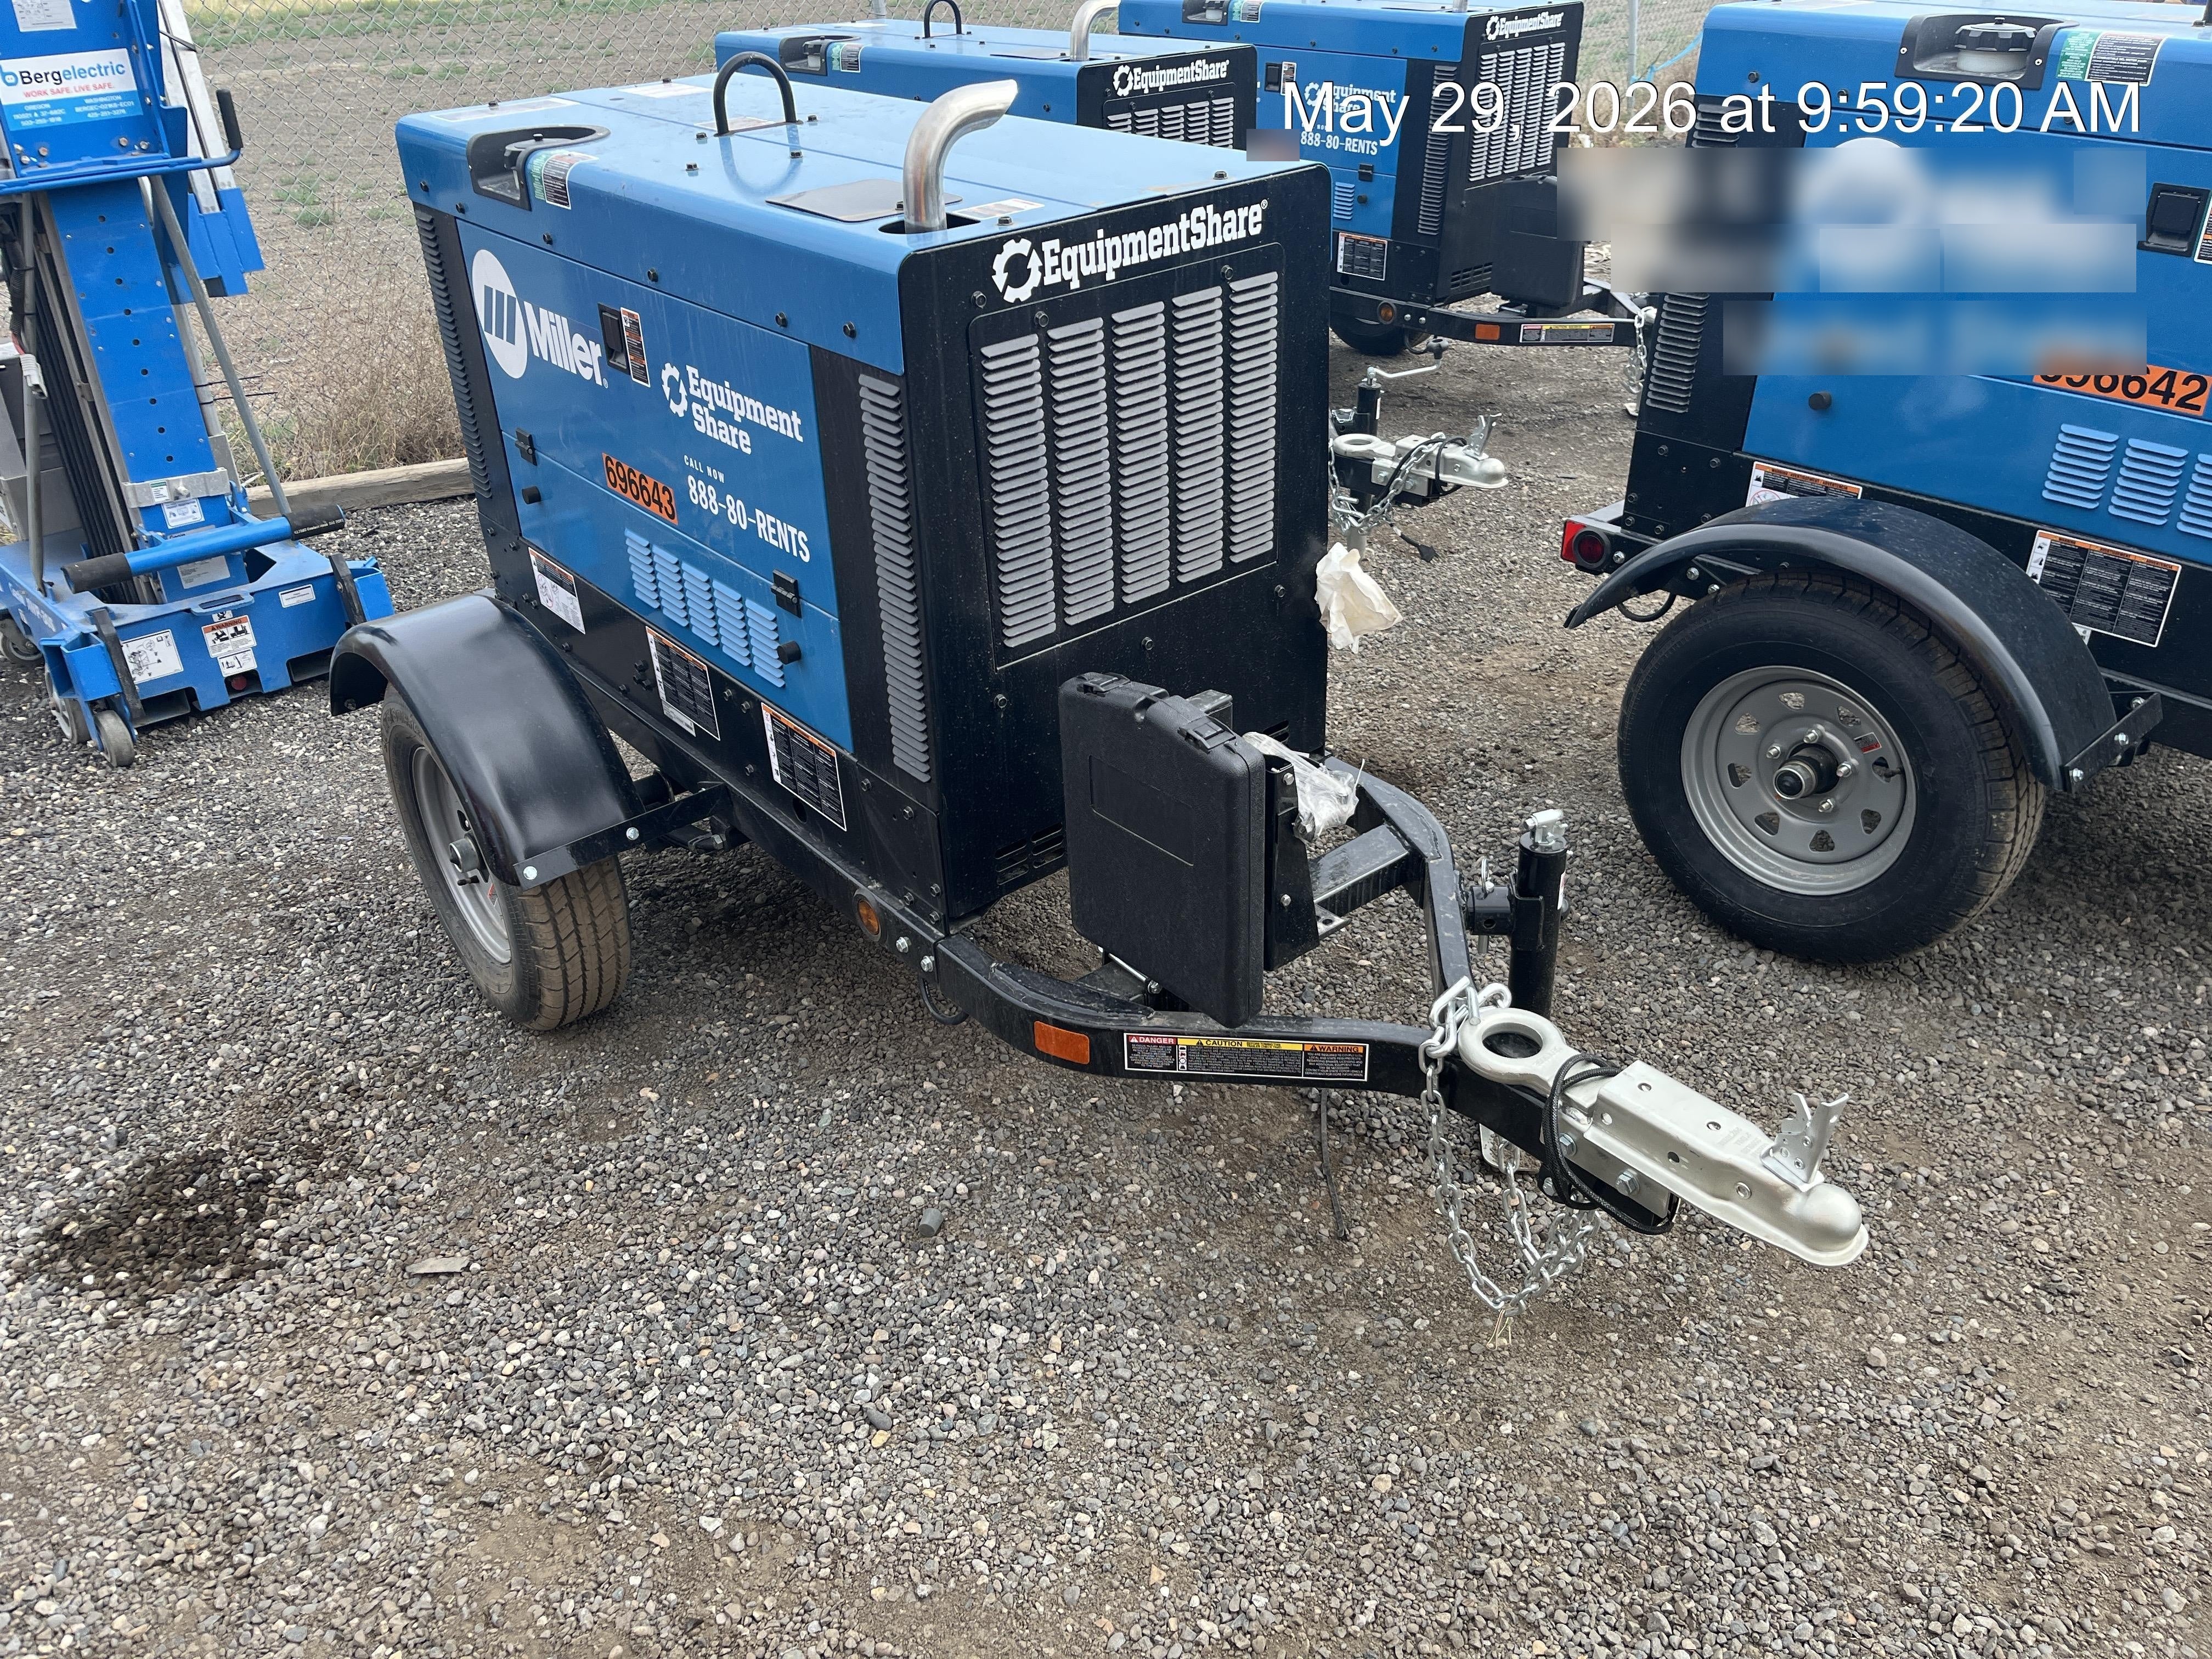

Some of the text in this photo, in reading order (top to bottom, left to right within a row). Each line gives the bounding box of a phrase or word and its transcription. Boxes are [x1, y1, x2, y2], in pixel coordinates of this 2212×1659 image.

[1499, 12, 1563, 38] EquipmentShare
[19, 61, 126, 85] Bergelectric
[23, 89, 49, 98] WORK
[74, 85, 91, 93] LIVE
[1133, 59, 1228, 94] EquipmentShare
[1300, 131, 1378, 156] 888-80-RENTS
[1042, 203, 1263, 290] EquipmentShare
[523, 301, 602, 386] Miller
[686, 364, 804, 442] Equipment
[2039, 365, 2208, 411] 6642
[691, 402, 752, 455] Share
[605, 455, 675, 520] 696643
[684, 455, 725, 483] CALL NOW
[687, 475, 810, 563] 888-80-RENTS
